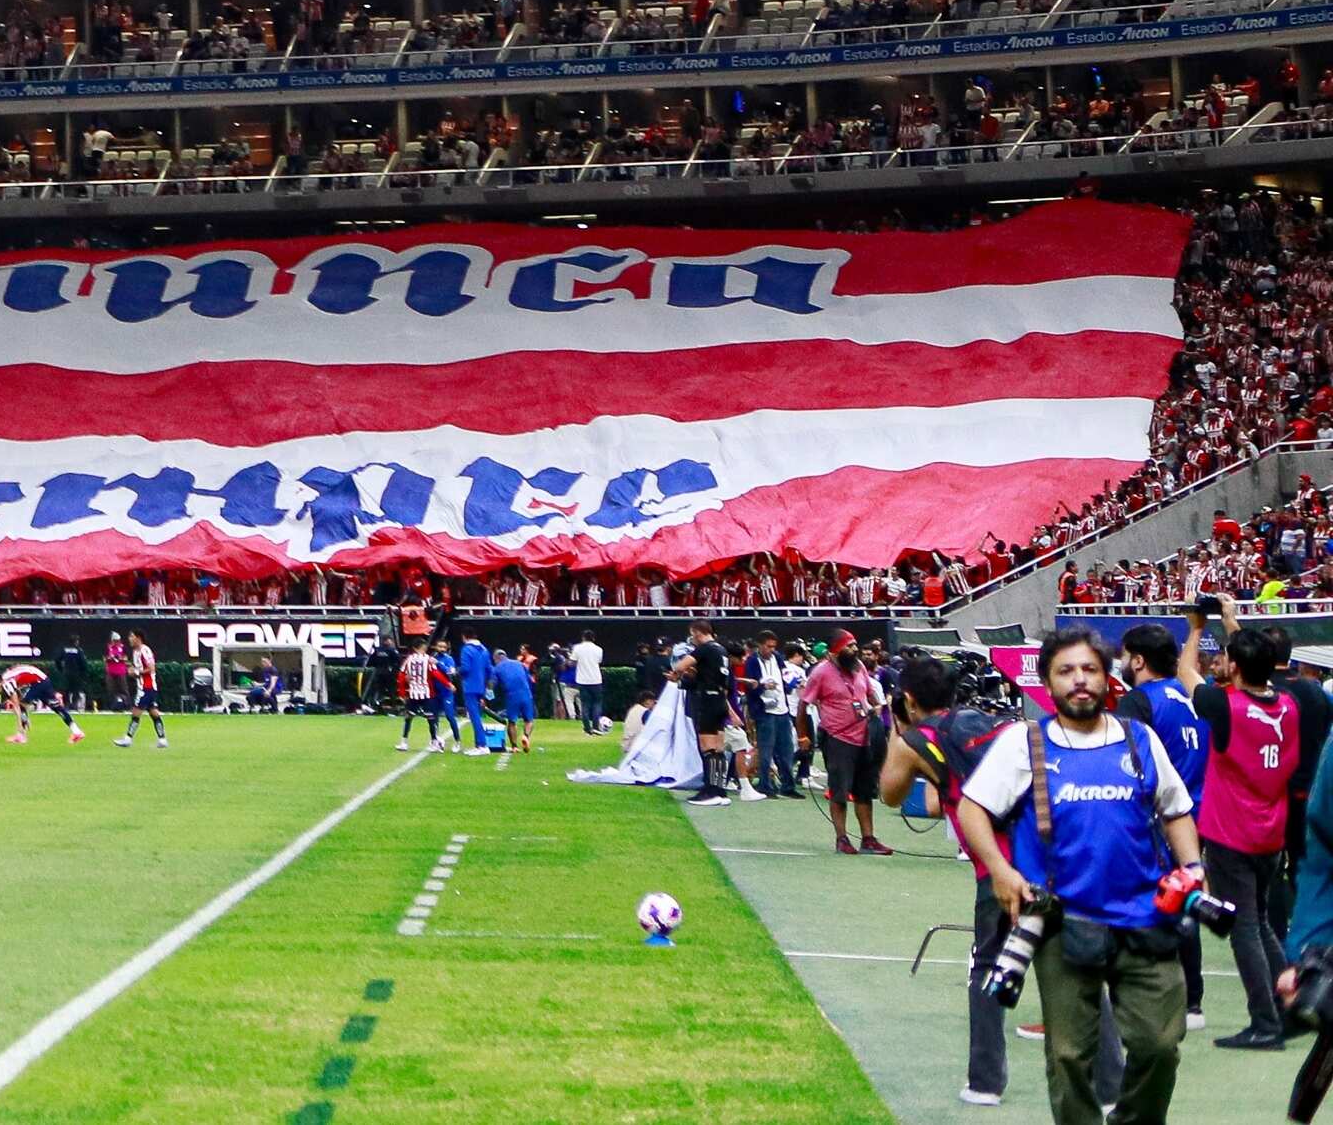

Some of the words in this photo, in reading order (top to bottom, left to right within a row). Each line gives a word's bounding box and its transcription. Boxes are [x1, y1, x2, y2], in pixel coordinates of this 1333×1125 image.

[1181, 19, 1226, 35] Estadio
[1067, 29, 1115, 45] Estadio
[953, 37, 1001, 53] Estadio
[731, 53, 778, 68] Estadio
[843, 46, 888, 61] Estadio
[507, 64, 553, 78] Estadio
[618, 59, 665, 72] Estadio
[290, 73, 334, 87] Estadio
[398, 69, 443, 82] Estadio
[77, 82, 121, 95] Estadio
[183, 78, 227, 91] Estadio
[1259, 744, 1280, 769] 16
[1054, 782, 1135, 805] AKRON
